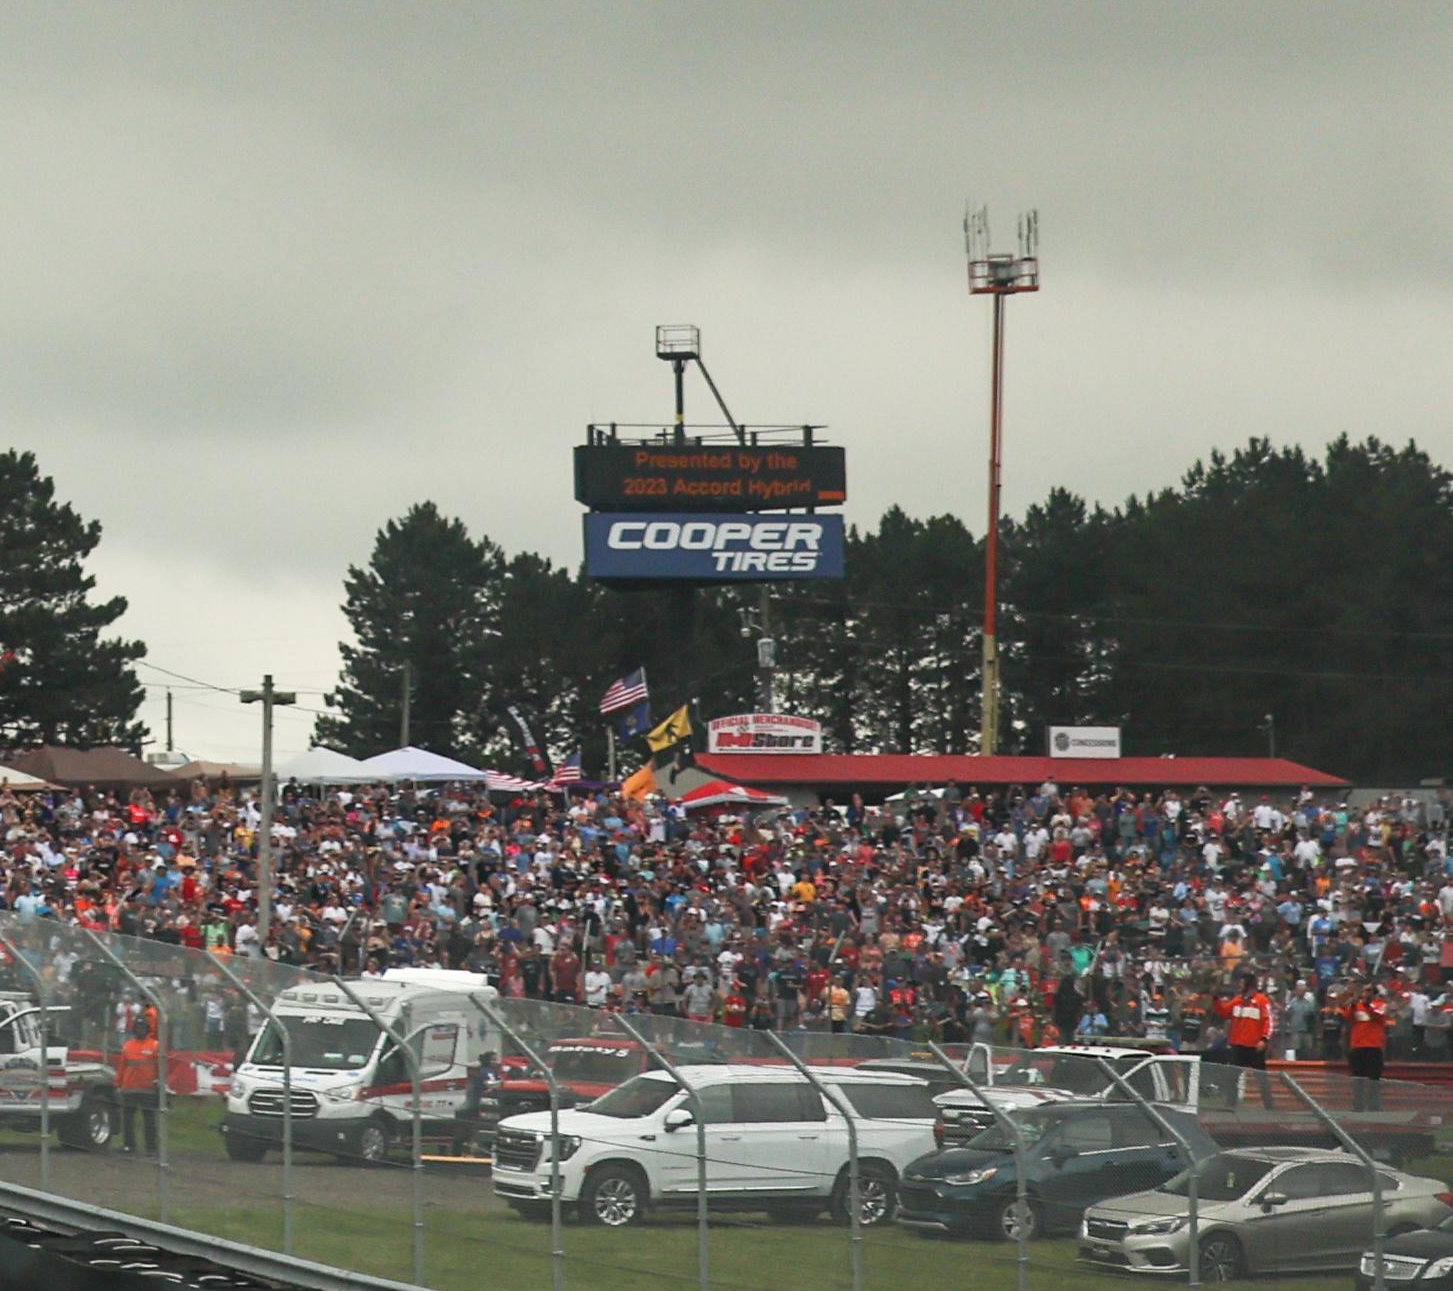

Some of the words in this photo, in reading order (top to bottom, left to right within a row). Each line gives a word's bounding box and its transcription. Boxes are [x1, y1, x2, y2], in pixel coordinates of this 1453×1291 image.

[634, 451, 731, 469] Presented
[739, 453, 761, 474] by
[767, 452, 797, 469] the
[624, 478, 668, 496] 2023
[673, 477, 740, 496] Accord
[607, 522, 823, 550] COOPER
[711, 551, 818, 572] TIRES
